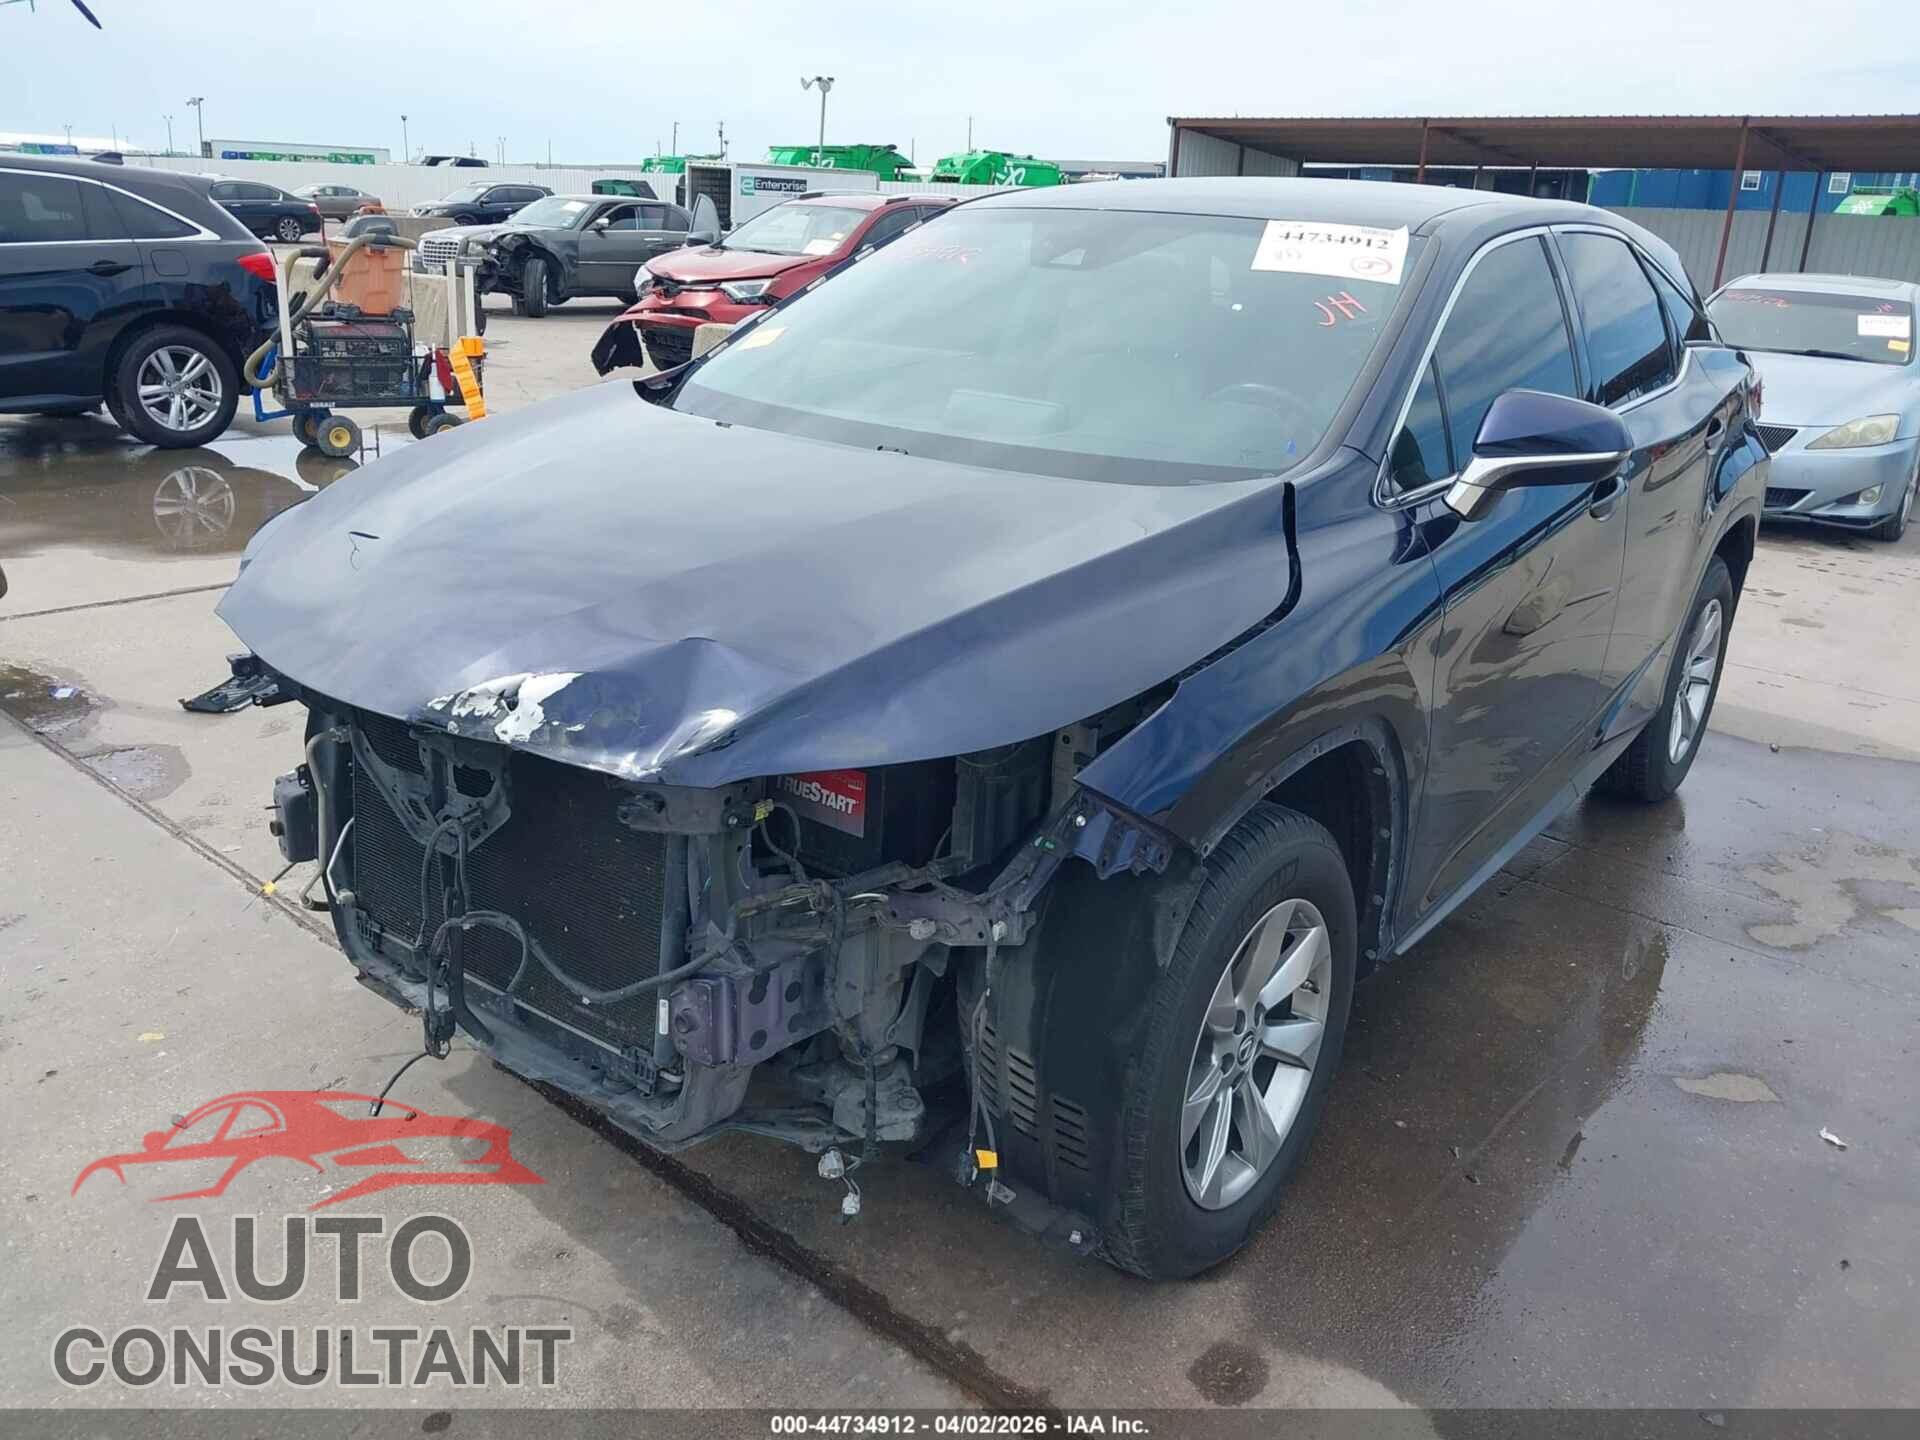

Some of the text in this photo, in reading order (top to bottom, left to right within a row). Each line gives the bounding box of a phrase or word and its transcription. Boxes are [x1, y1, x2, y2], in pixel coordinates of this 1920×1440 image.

[755, 178, 807, 191] Enterprise
[1279, 231, 1389, 249] 44734912
[776, 775, 856, 814] TRUESTART
